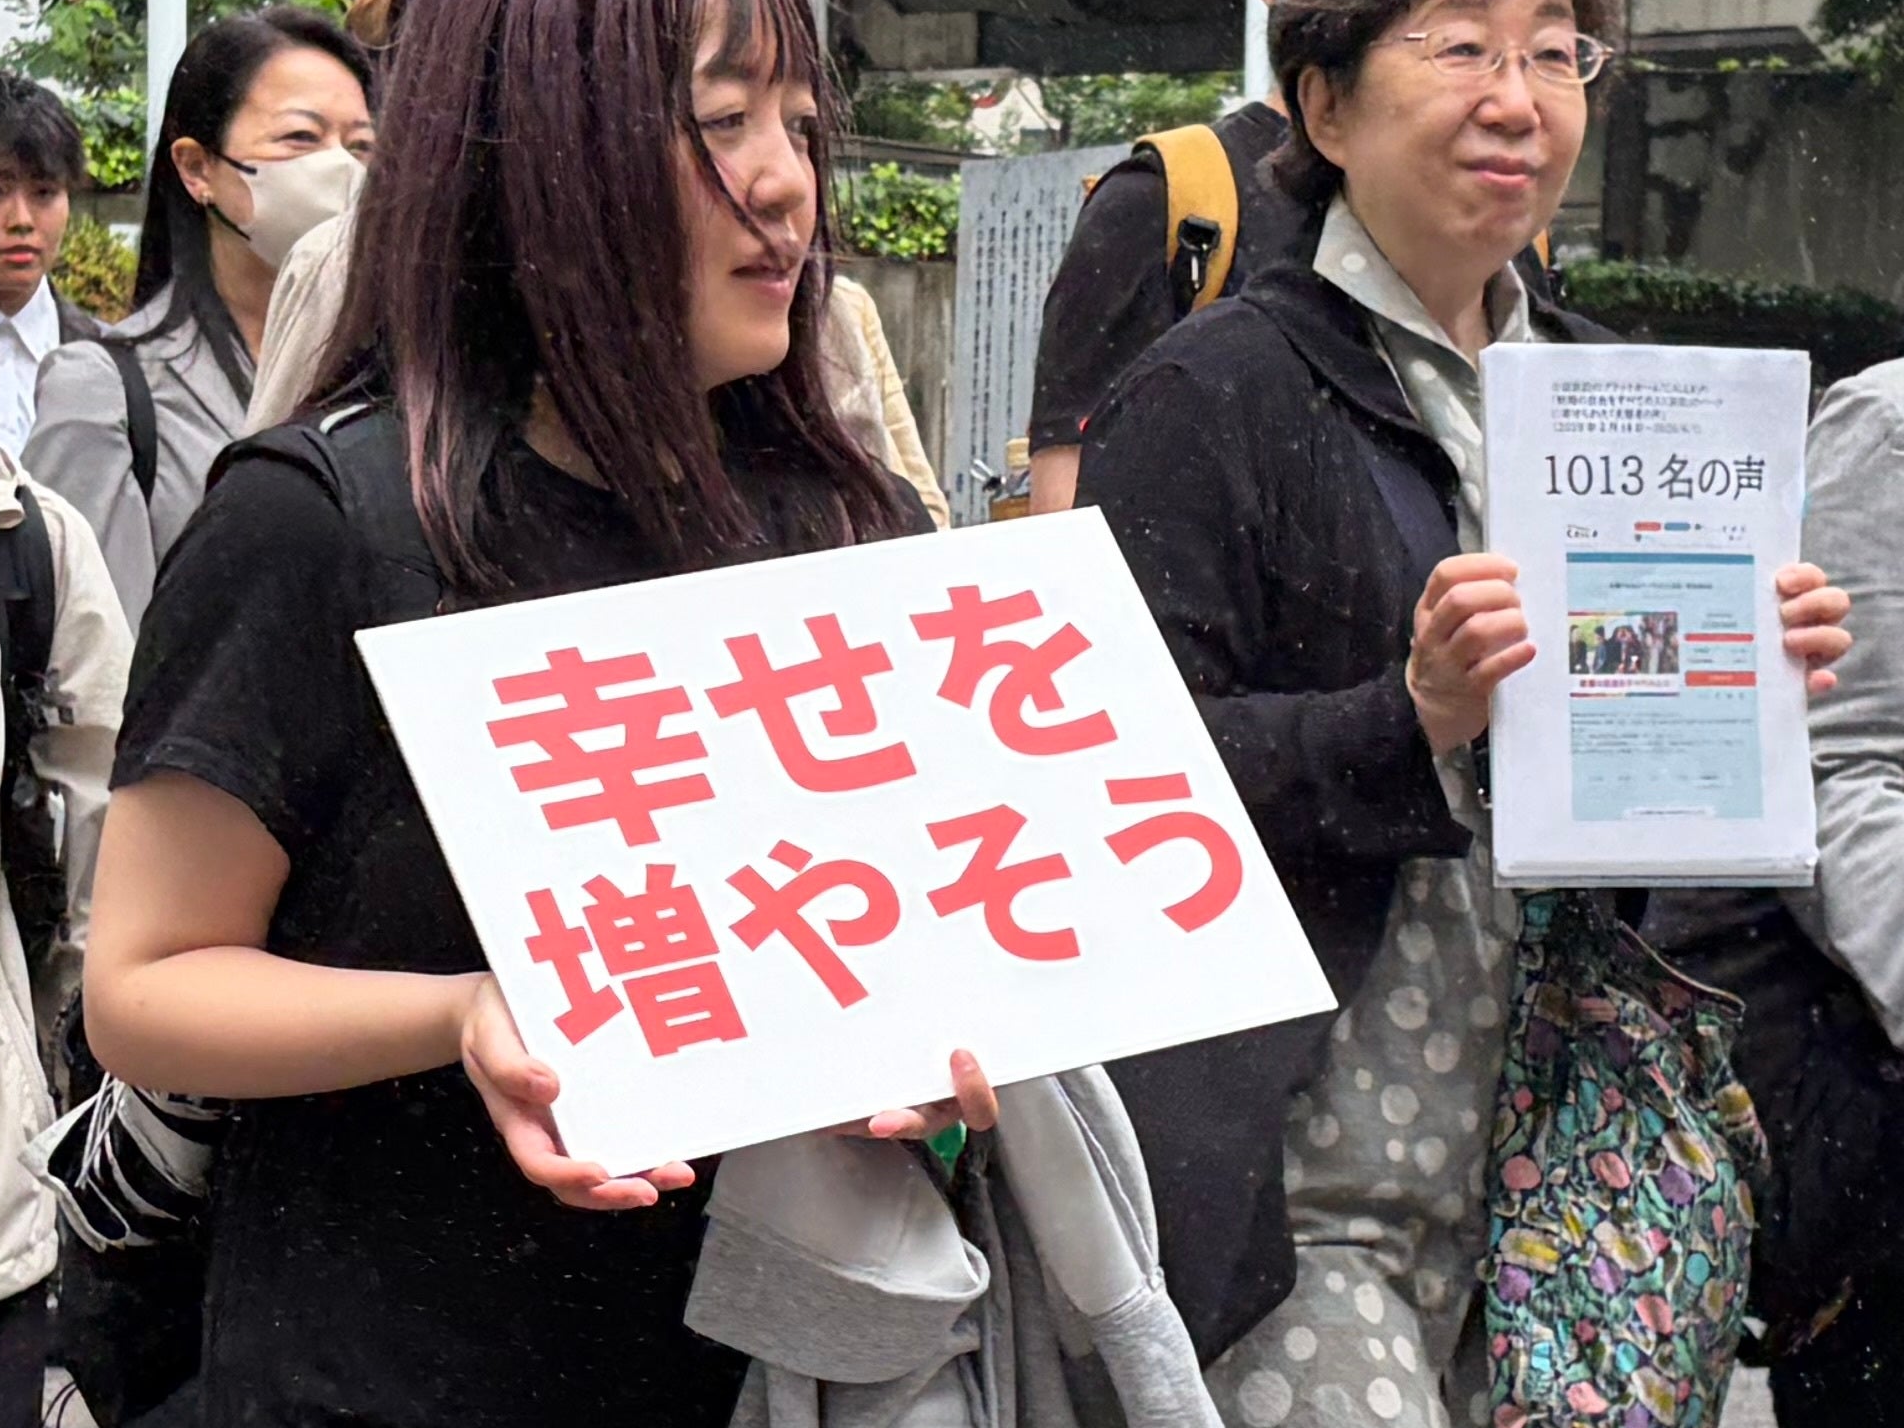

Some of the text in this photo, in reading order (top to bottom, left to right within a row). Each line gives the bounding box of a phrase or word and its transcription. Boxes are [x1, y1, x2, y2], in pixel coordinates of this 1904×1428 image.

[1545, 453, 1765, 500] 1013 名の声
[486, 585, 1118, 848] 幸せを
[525, 772, 1245, 1059] 増やそう
